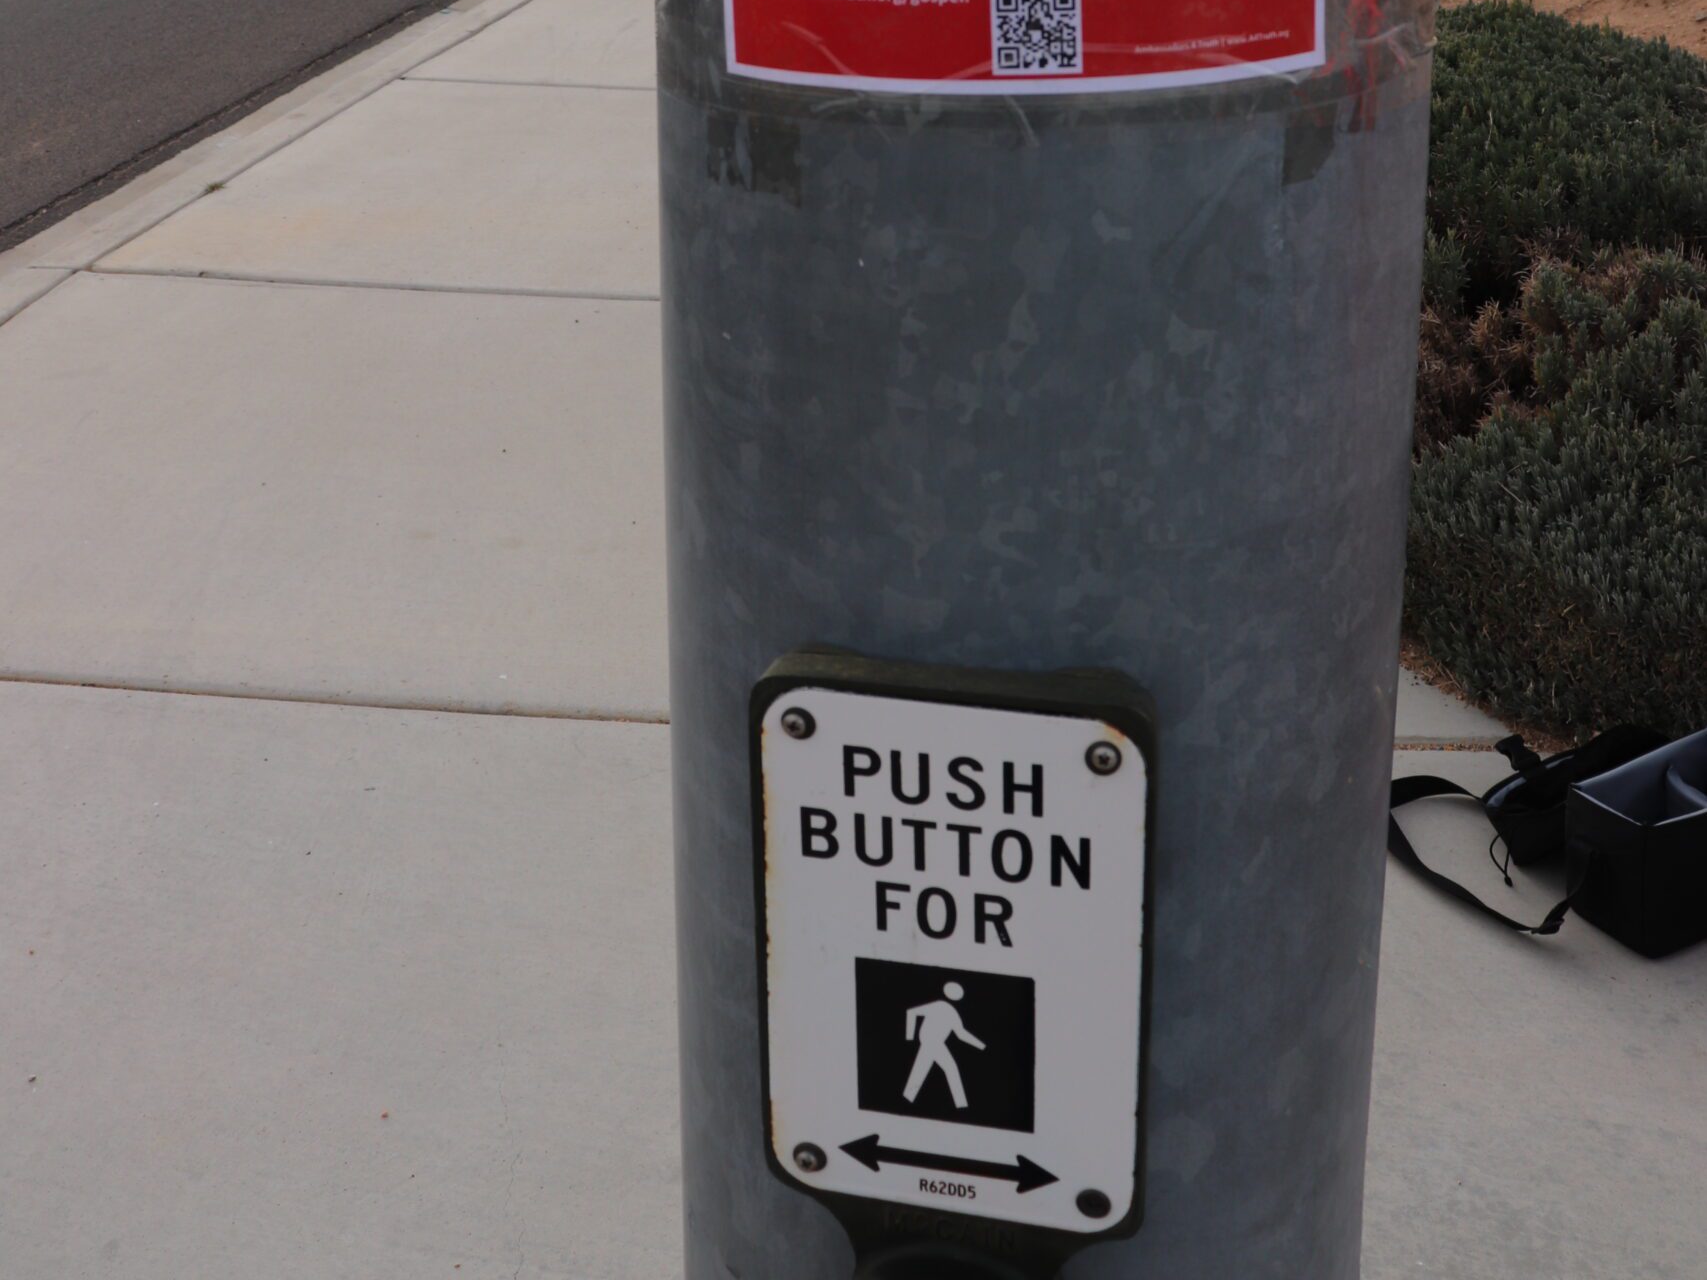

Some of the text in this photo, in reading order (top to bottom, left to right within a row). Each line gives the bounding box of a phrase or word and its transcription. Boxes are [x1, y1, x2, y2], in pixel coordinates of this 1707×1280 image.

[842, 744, 1044, 818] PUSH
[800, 806, 1091, 890] BUTTON
[875, 882, 1014, 948] FOR
[918, 1178, 976, 1199] R62DD5
